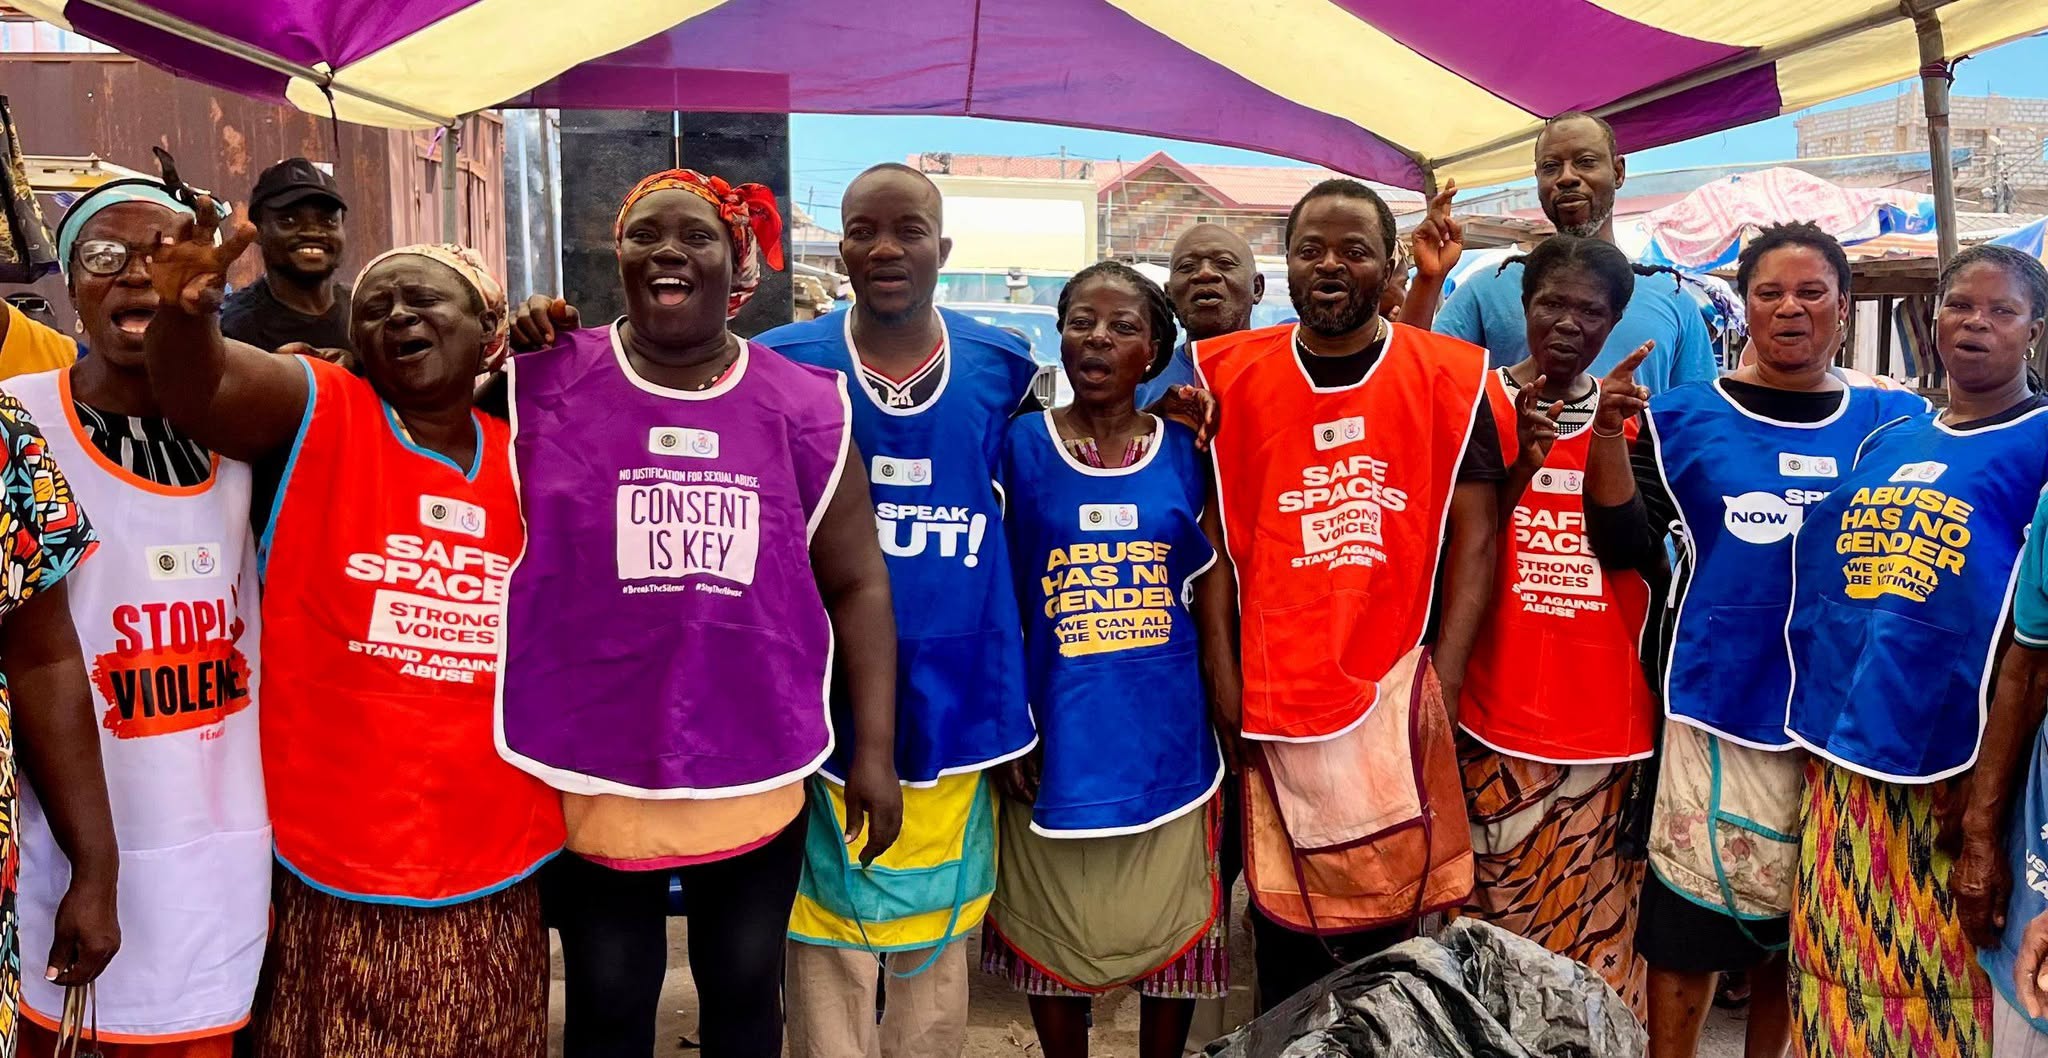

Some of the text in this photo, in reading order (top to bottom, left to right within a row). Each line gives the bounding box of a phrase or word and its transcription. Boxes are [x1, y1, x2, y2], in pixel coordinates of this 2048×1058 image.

[620, 470, 630, 480] NO
[632, 467, 685, 481] JUSTIFICATION
[688, 472, 703, 482] FOR
[705, 471, 733, 483] SEXUAL
[1302, 455, 1388, 487] SAFE
[1278, 477, 1408, 513] SPACES
[1850, 487, 1974, 524] ABUSE
[631, 488, 750, 529] CONSENT
[876, 502, 968, 522] SPEAK
[1312, 509, 1378, 530] STRONG
[1731, 512, 1787, 524] NOW
[1318, 522, 1377, 542] VOICES
[1841, 508, 1971, 548] HAS NO
[649, 529, 734, 571] IS KEY
[875, 513, 987, 568] UT!
[386, 534, 510, 577] SAFE
[1047, 541, 1171, 571] ABUSE
[1291, 544, 1388, 568] STAND AGAINST
[1328, 555, 1373, 571] ABUSE
[1836, 532, 1966, 576] GENDER
[345, 553, 504, 604] SPACE
[1517, 559, 1593, 574] STRONG
[1847, 562, 1872, 573] WE
[1899, 566, 1938, 586] ALL
[1041, 565, 1168, 596] HAS NO
[1851, 576, 1872, 585] BE
[389, 602, 499, 627] STRONG
[1523, 603, 1575, 618] ABUSE
[1542, 595, 1608, 612] AGAINST
[113, 599, 226, 658] STOP!
[395, 621, 494, 644] VOICES
[1058, 616, 1172, 631] WE CAN ALL
[1064, 628, 1169, 643] BE VICTIMS
[348, 640, 497, 672] STAND AGAIN
[400, 663, 474, 683] ABUSE
